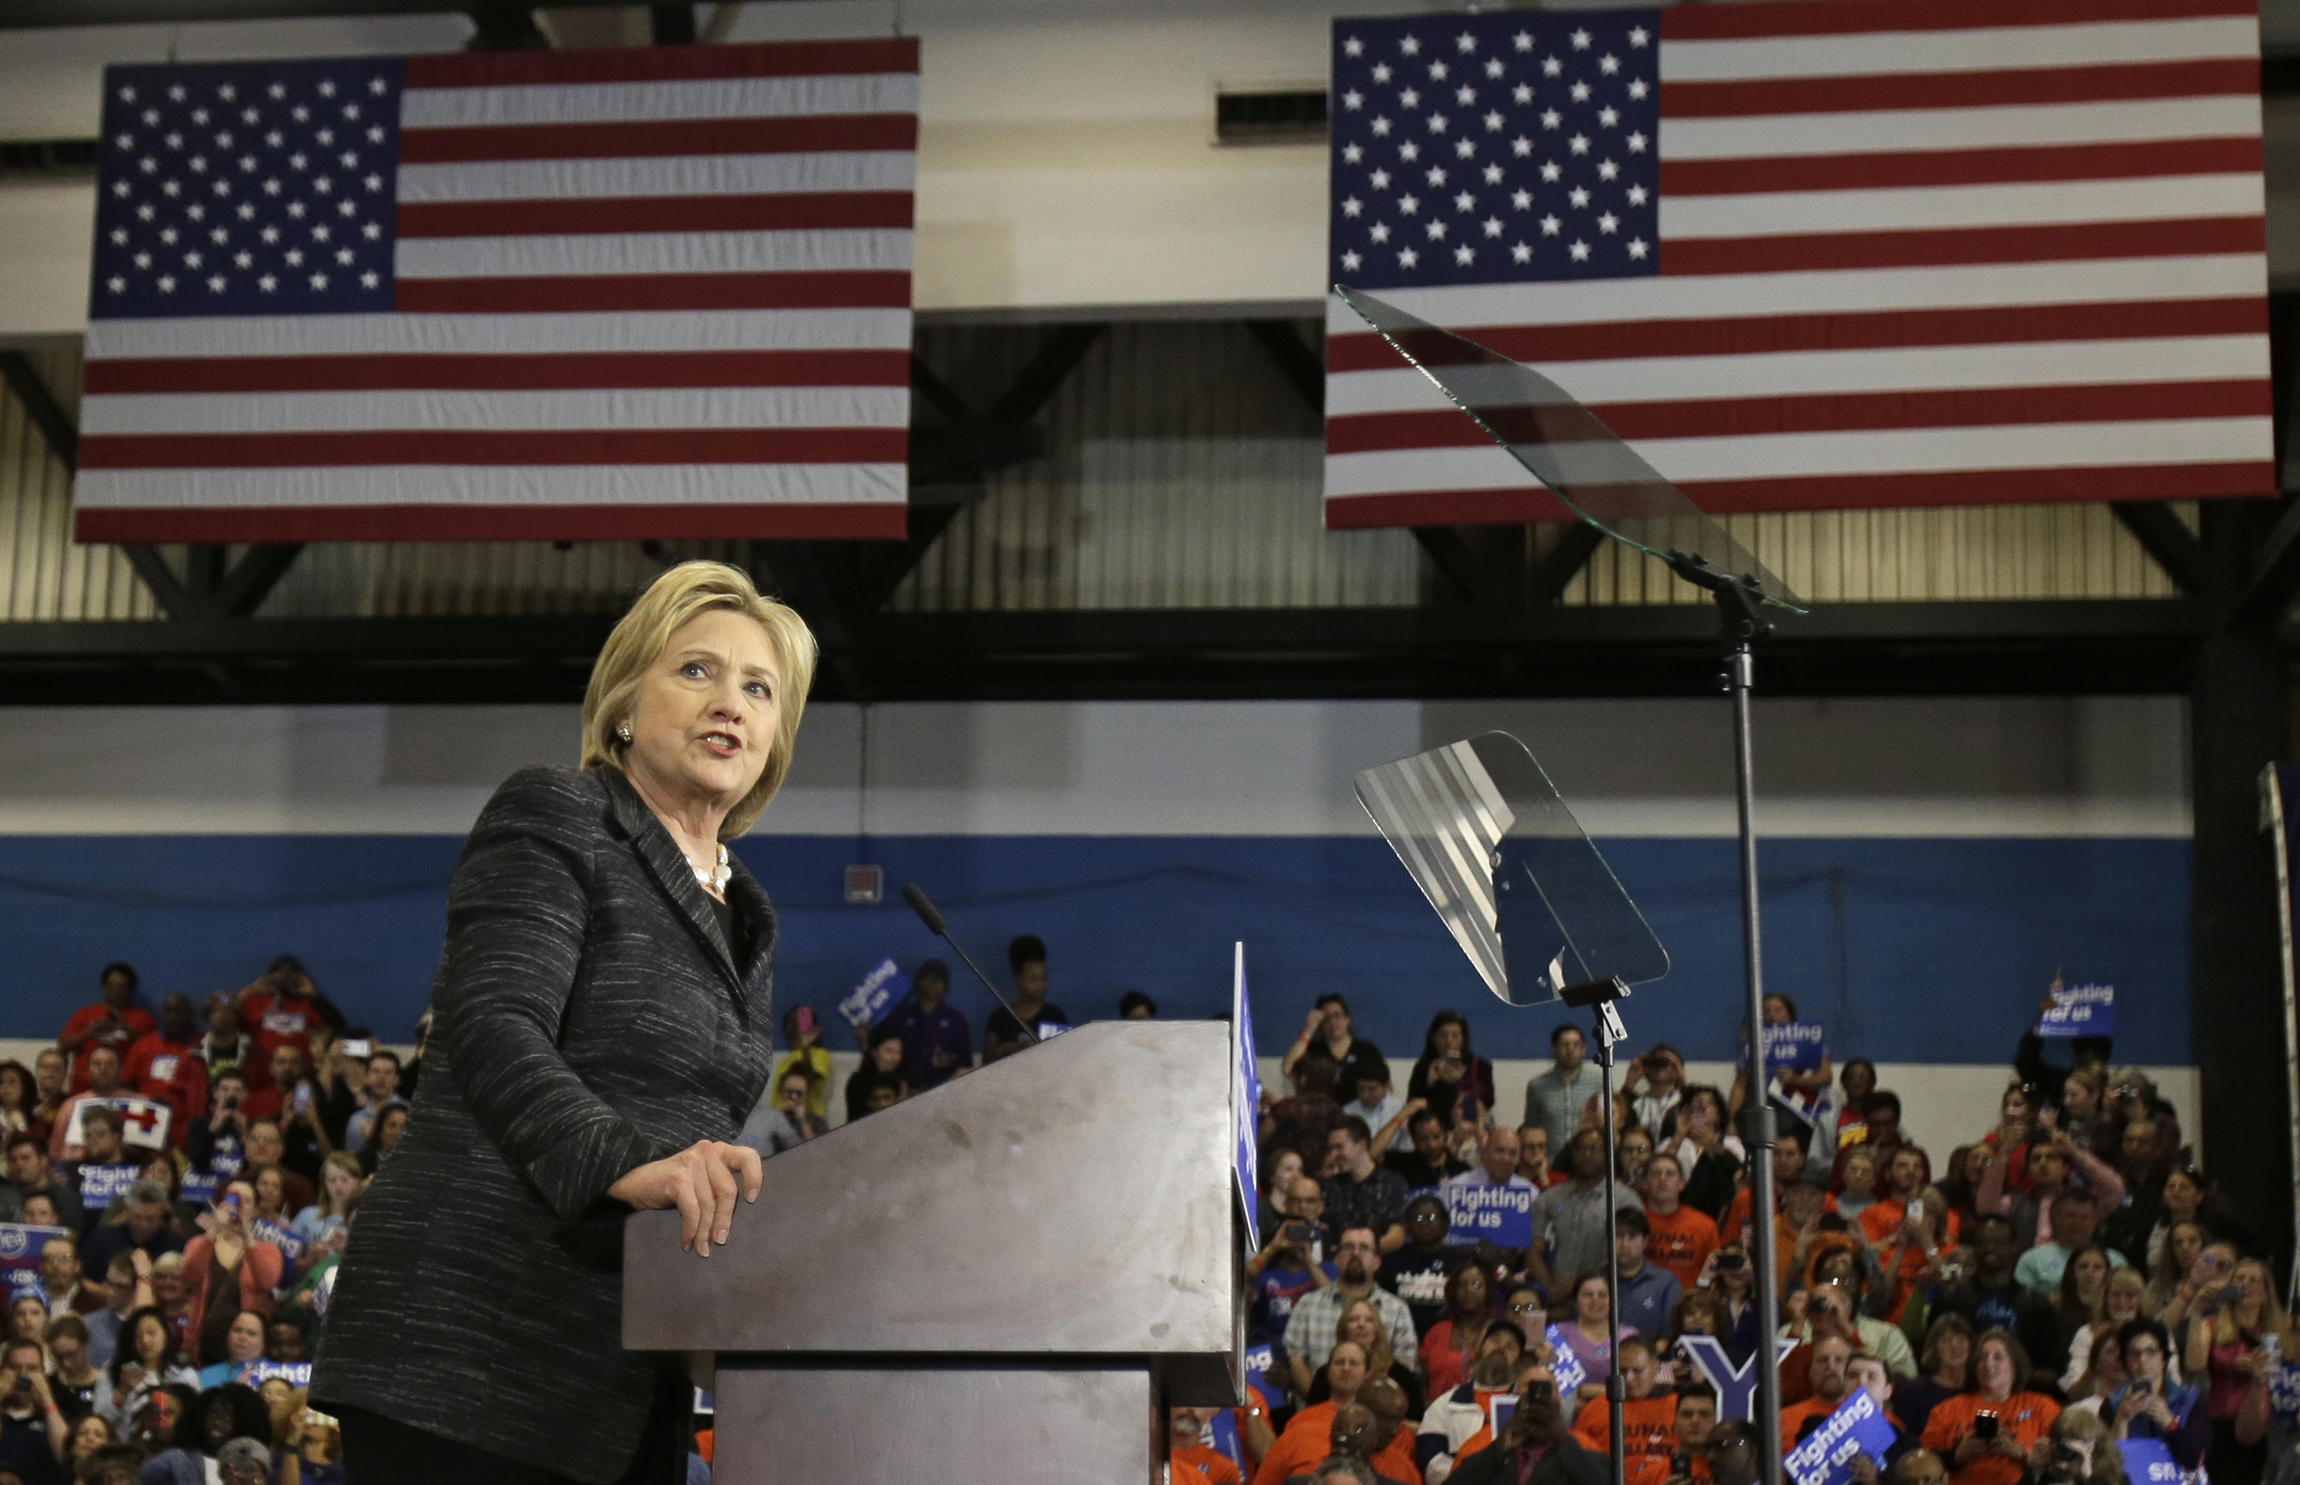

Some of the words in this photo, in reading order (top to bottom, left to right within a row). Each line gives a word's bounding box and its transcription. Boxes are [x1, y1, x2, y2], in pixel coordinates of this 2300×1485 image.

[2051, 983, 2114, 1006] ighting
[1762, 1022, 1822, 1045] ghting
[1450, 1186, 1530, 1214] Fighting
[1450, 1204, 1477, 1228] for
[1478, 1211, 1502, 1228] us
[1679, 1335, 1800, 1425] Y
[1783, 1392, 1875, 1480] Fighting
[1830, 1436, 1861, 1468] us
